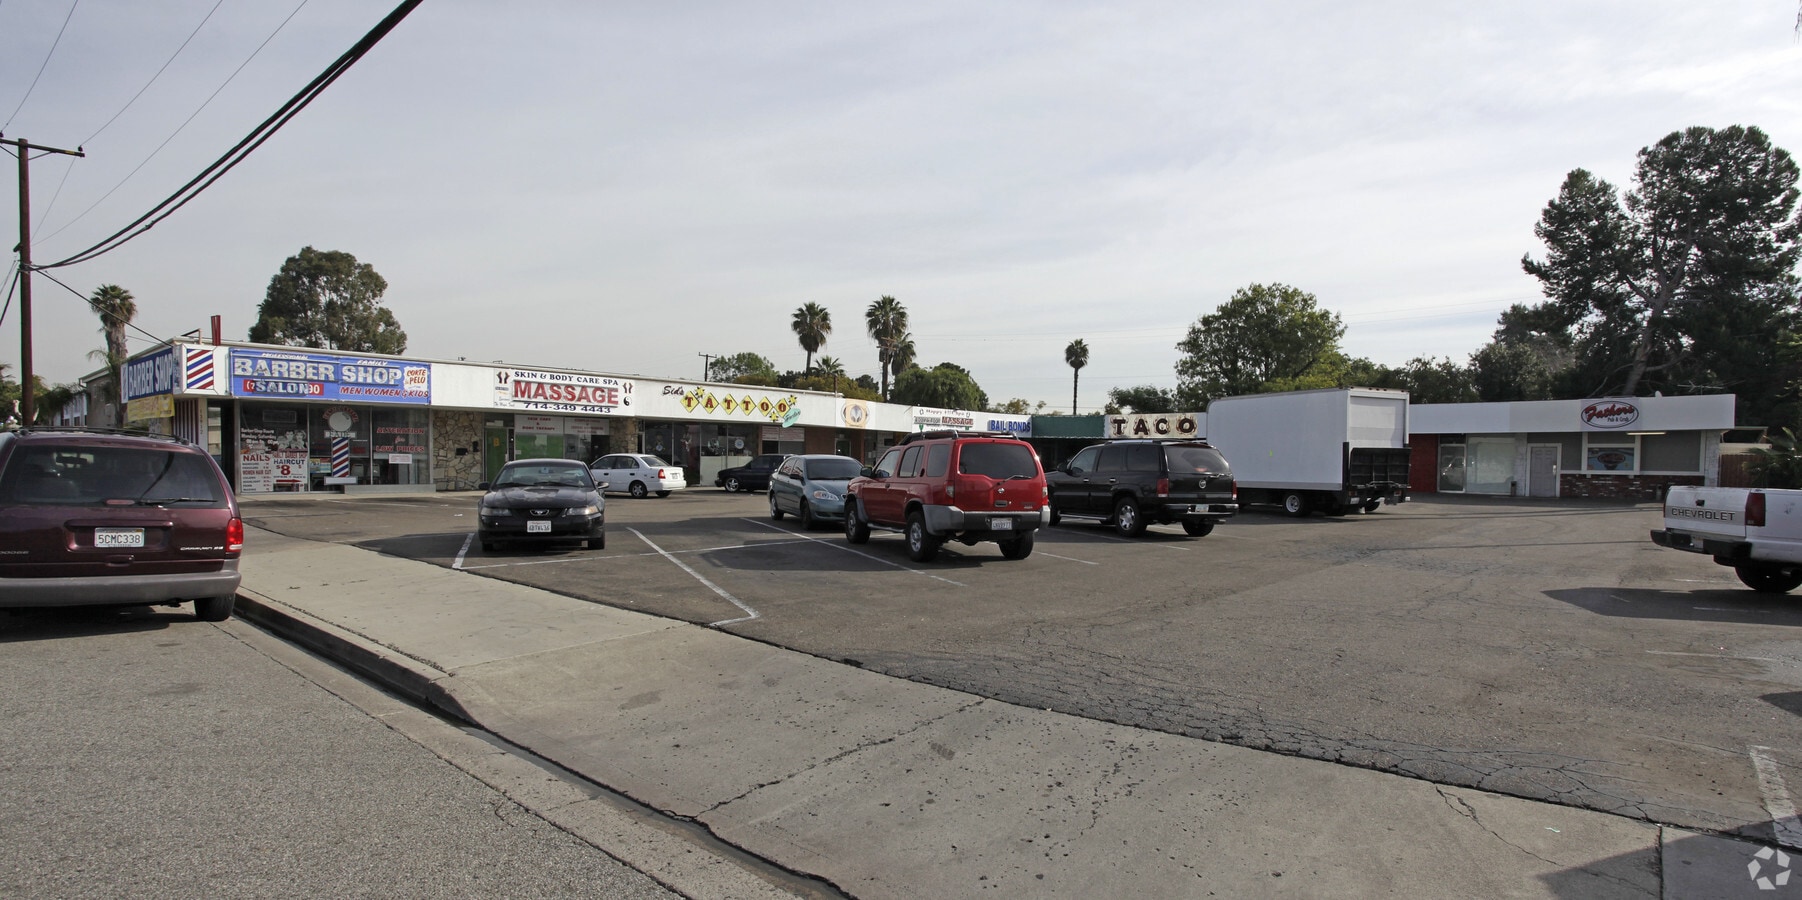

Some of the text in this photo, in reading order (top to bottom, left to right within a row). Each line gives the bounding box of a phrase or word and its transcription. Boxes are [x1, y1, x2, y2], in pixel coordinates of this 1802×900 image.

[129, 360, 154, 397] BARBER
[155, 353, 173, 392] SHOP
[234, 358, 402, 384] BARBER SHOP
[407, 369, 427, 377] CORTE
[409, 376, 426, 384] PELO
[514, 371, 537, 379] SKIN
[549, 374, 574, 382] BODY
[577, 376, 600, 384] CARE
[603, 378, 619, 386] SPA
[256, 381, 309, 394] SALON
[365, 388, 400, 396] WOMEN
[408, 390, 429, 398] KIDS
[514, 380, 619, 405] MASSAGE
[523, 402, 577, 411] 714-349
[581, 405, 611, 413] 4443
[685, 396, 787, 412] TATTOO
[941, 416, 974, 425] MASSAGE
[990, 420, 1031, 432] BAIL BONDS
[1112, 418, 1195, 435] TACO
[243, 454, 270, 462] NAILS
[1671, 508, 1735, 520] CHEVROLET
[98, 534, 141, 544] 5CMC338
